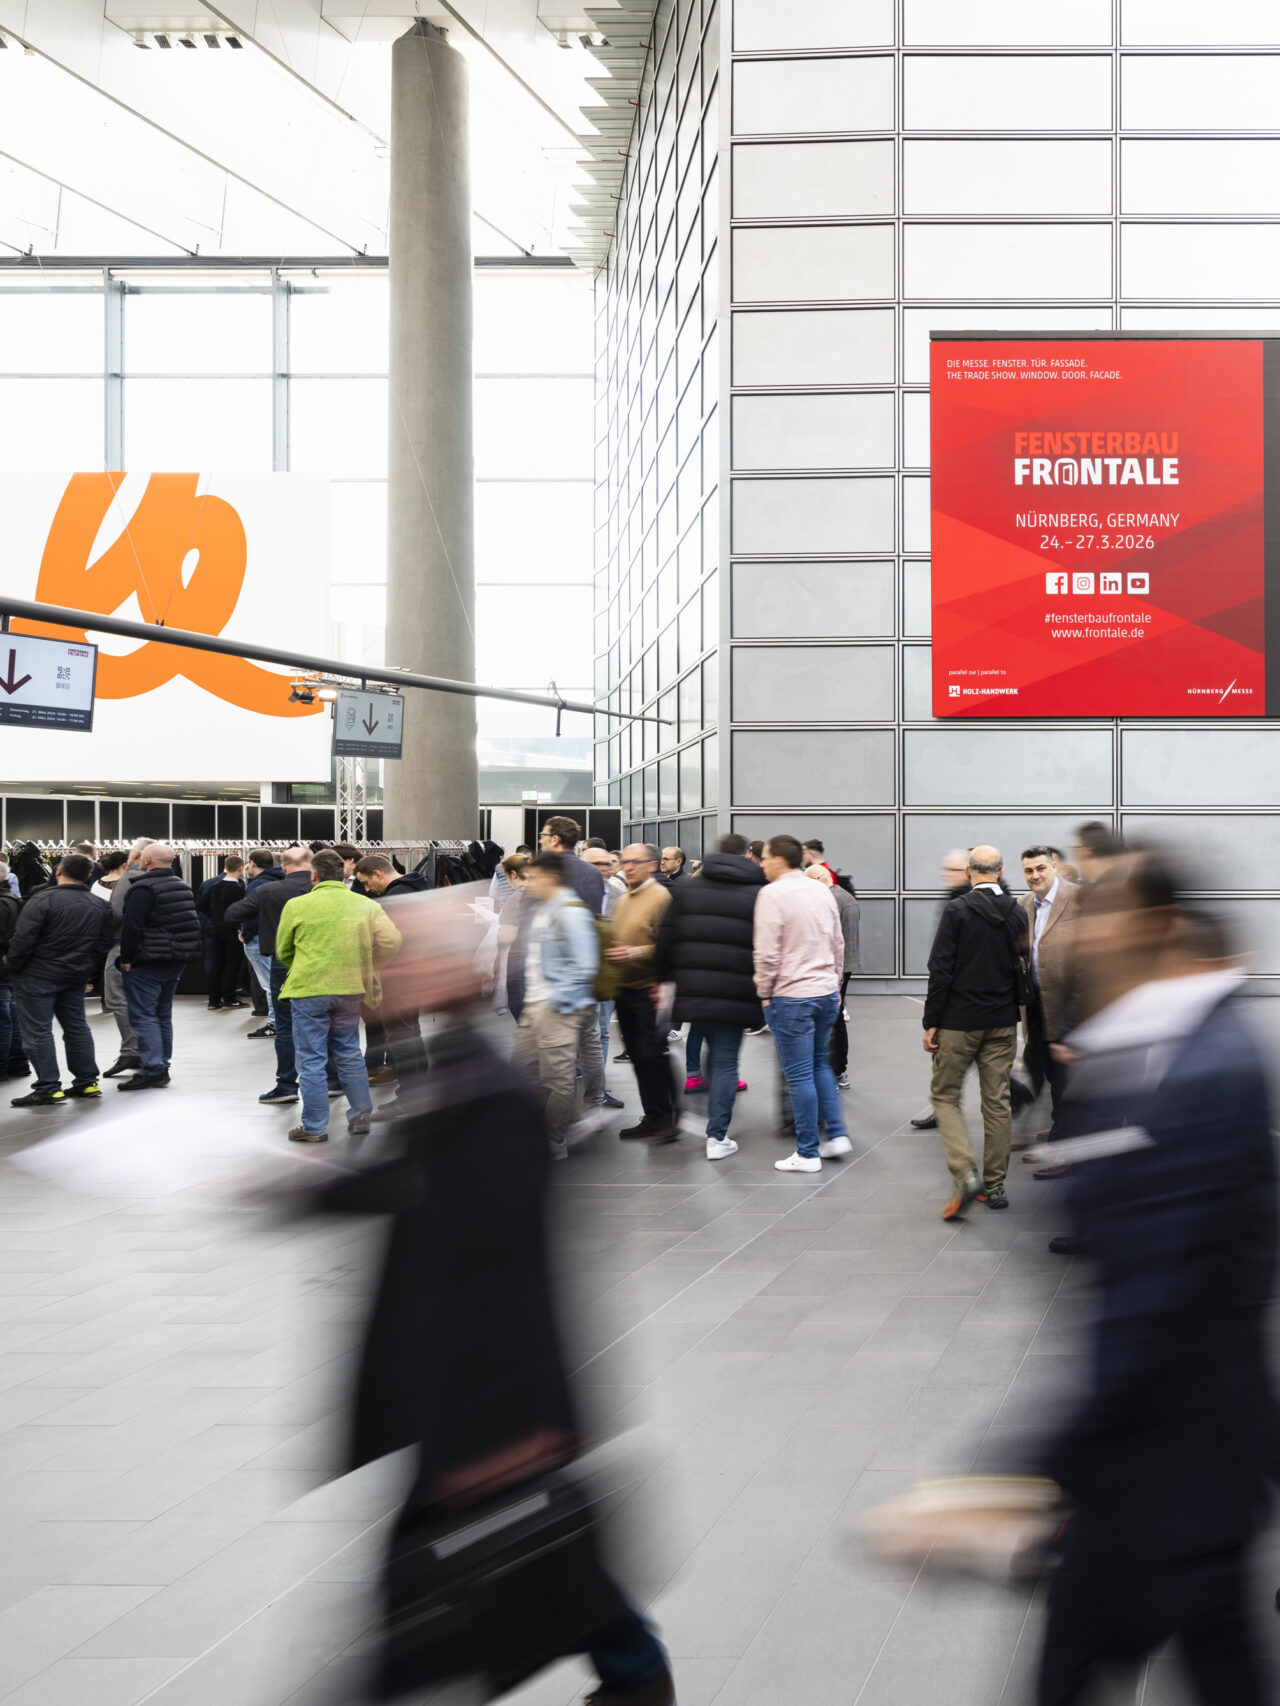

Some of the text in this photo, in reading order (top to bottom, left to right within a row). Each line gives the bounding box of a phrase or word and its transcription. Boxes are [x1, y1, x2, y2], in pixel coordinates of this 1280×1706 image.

[947, 358, 1087, 368] DIE MESSE. FENSTER. TÜR. FASSADE.
[947, 371, 1122, 379] THE TRADE SHOW. WINDOW. DOOR. FACADE.
[1015, 432, 1178, 455] FENSTERBAU
[1015, 458, 1179, 485] FRONTALE
[1016, 510, 1179, 529] NÜRNBERG, GERMANY
[1045, 612, 1151, 623] #fensterbaufrontale
[1052, 627, 1144, 638] www.frontale.de
